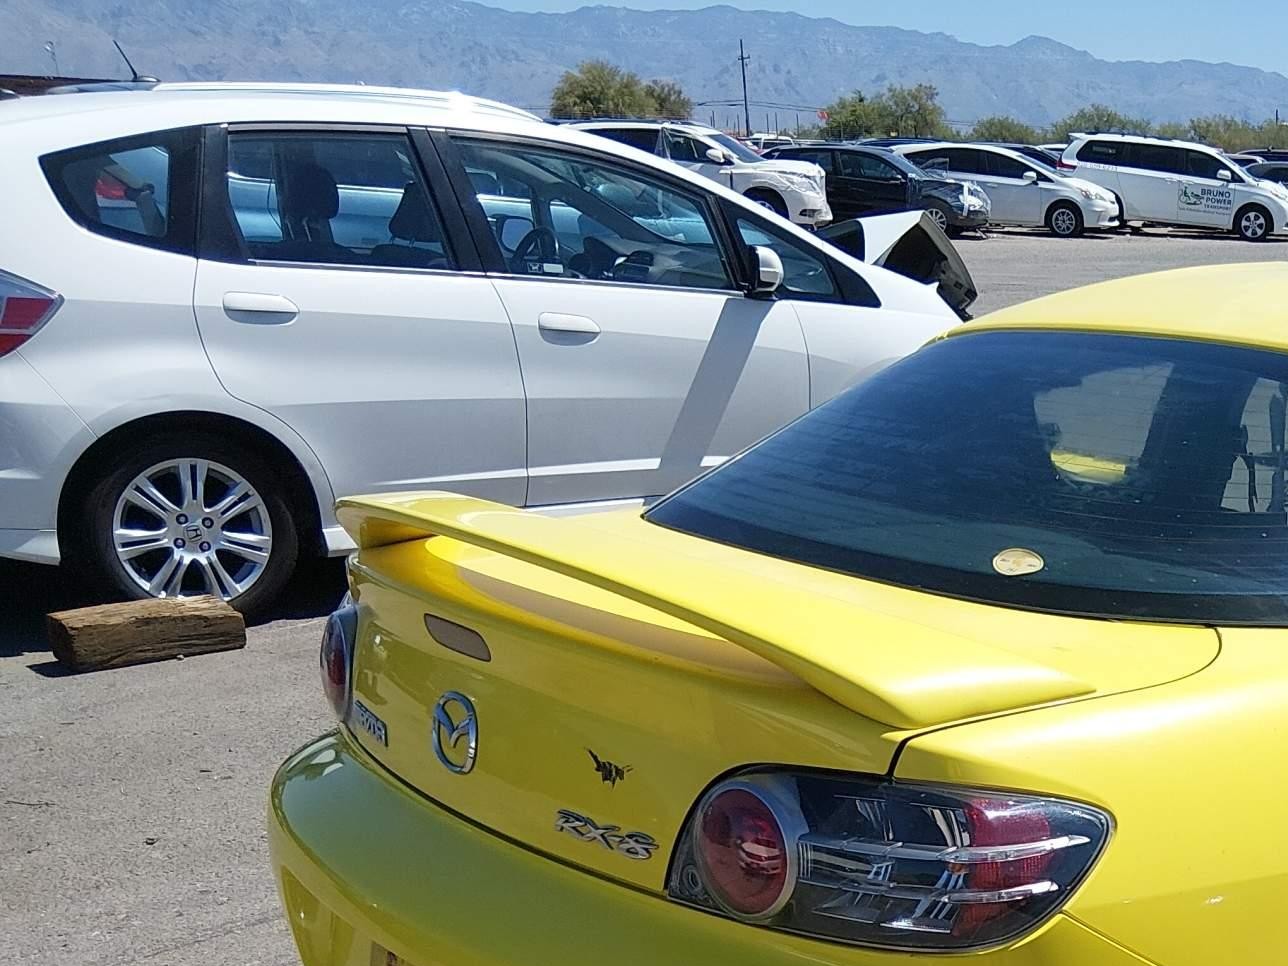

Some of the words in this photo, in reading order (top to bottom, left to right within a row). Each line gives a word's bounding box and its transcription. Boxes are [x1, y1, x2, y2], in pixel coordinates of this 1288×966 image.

[1200, 188, 1231, 199] BRUNO
[1205, 197, 1232, 206] POWER
[555, 808, 660, 860] RX-8
